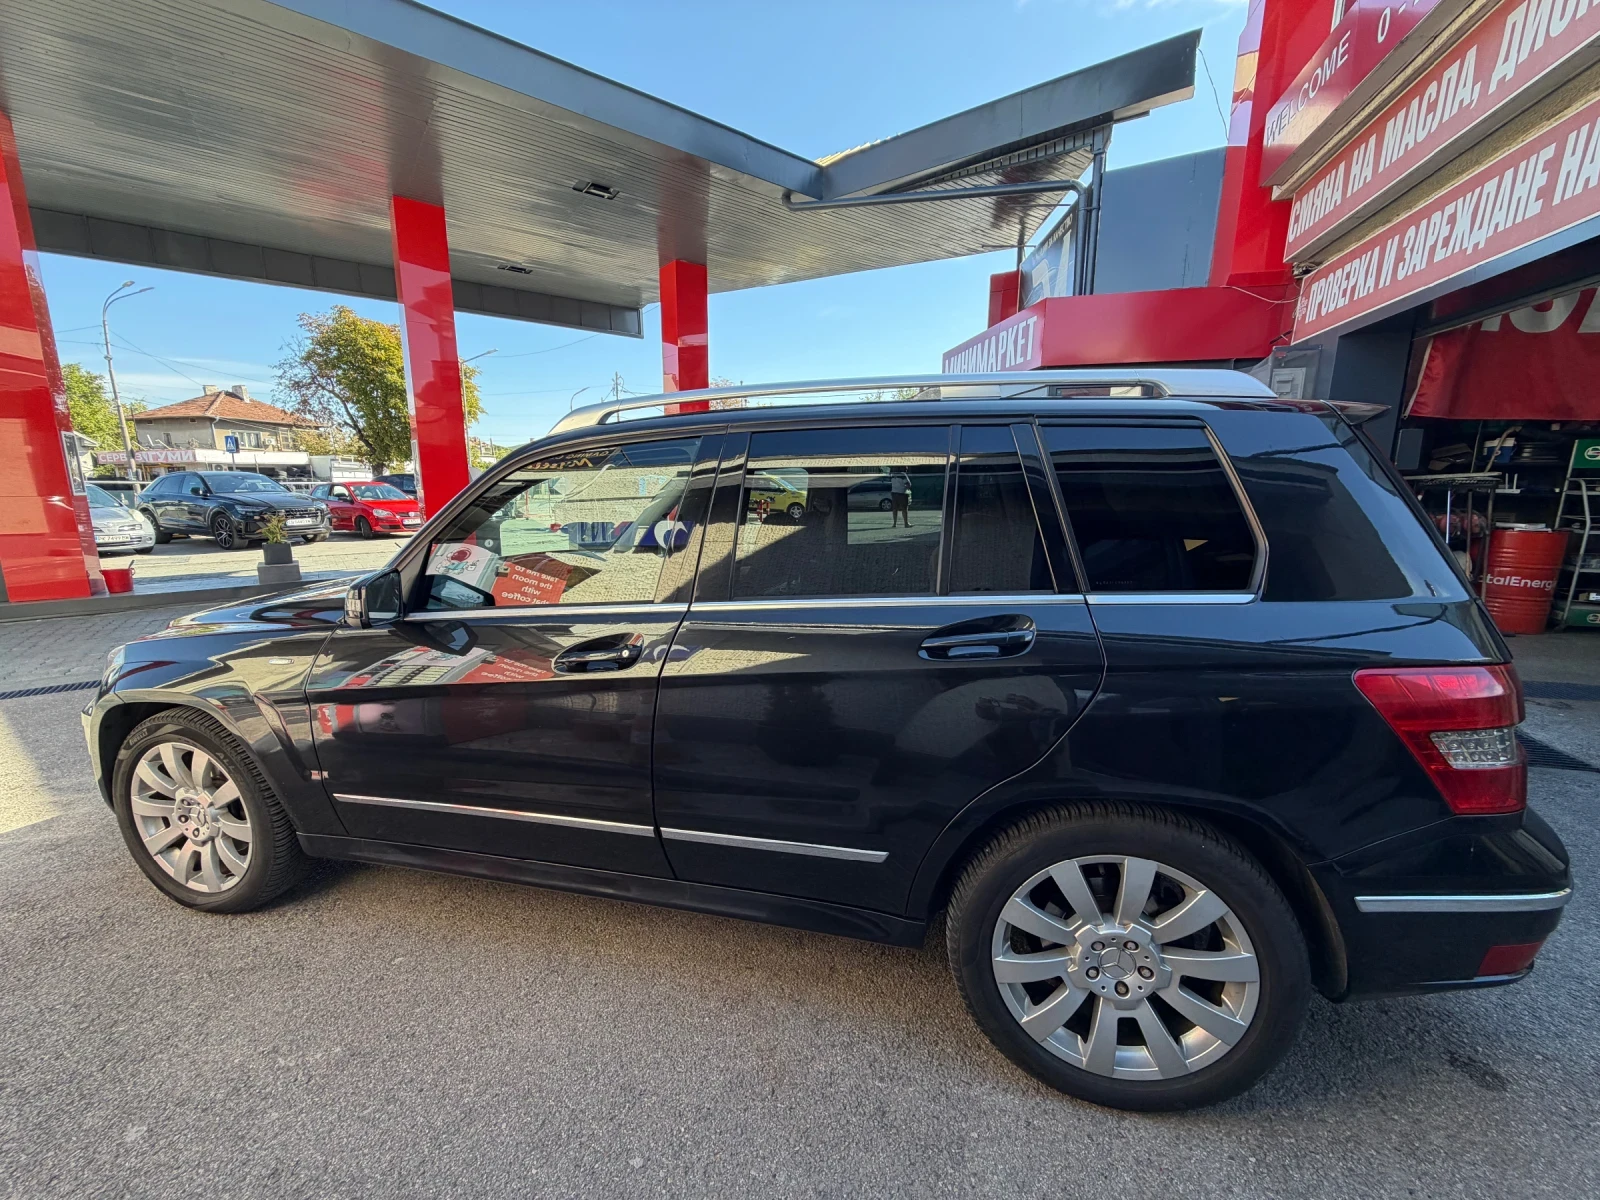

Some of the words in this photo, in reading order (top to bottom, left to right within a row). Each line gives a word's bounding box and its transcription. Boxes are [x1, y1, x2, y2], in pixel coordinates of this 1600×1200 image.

[1266, 29, 1351, 148] WELCOME
[1288, 160, 1346, 243] СМЯНА
[1346, 133, 1377, 198] НА
[1378, 44, 1482, 174] МАСЛА,
[1488, 0, 1600, 95] ДИС
[1305, 246, 1380, 324] ПРОВЕРКА
[1378, 234, 1400, 289] И
[1397, 142, 1557, 280] ЗАРЕЖДАНЕ
[1552, 114, 1600, 206] НА
[100, 453, 142, 462] СЕРВЗ
[146, 451, 194, 462] ГУМИ
